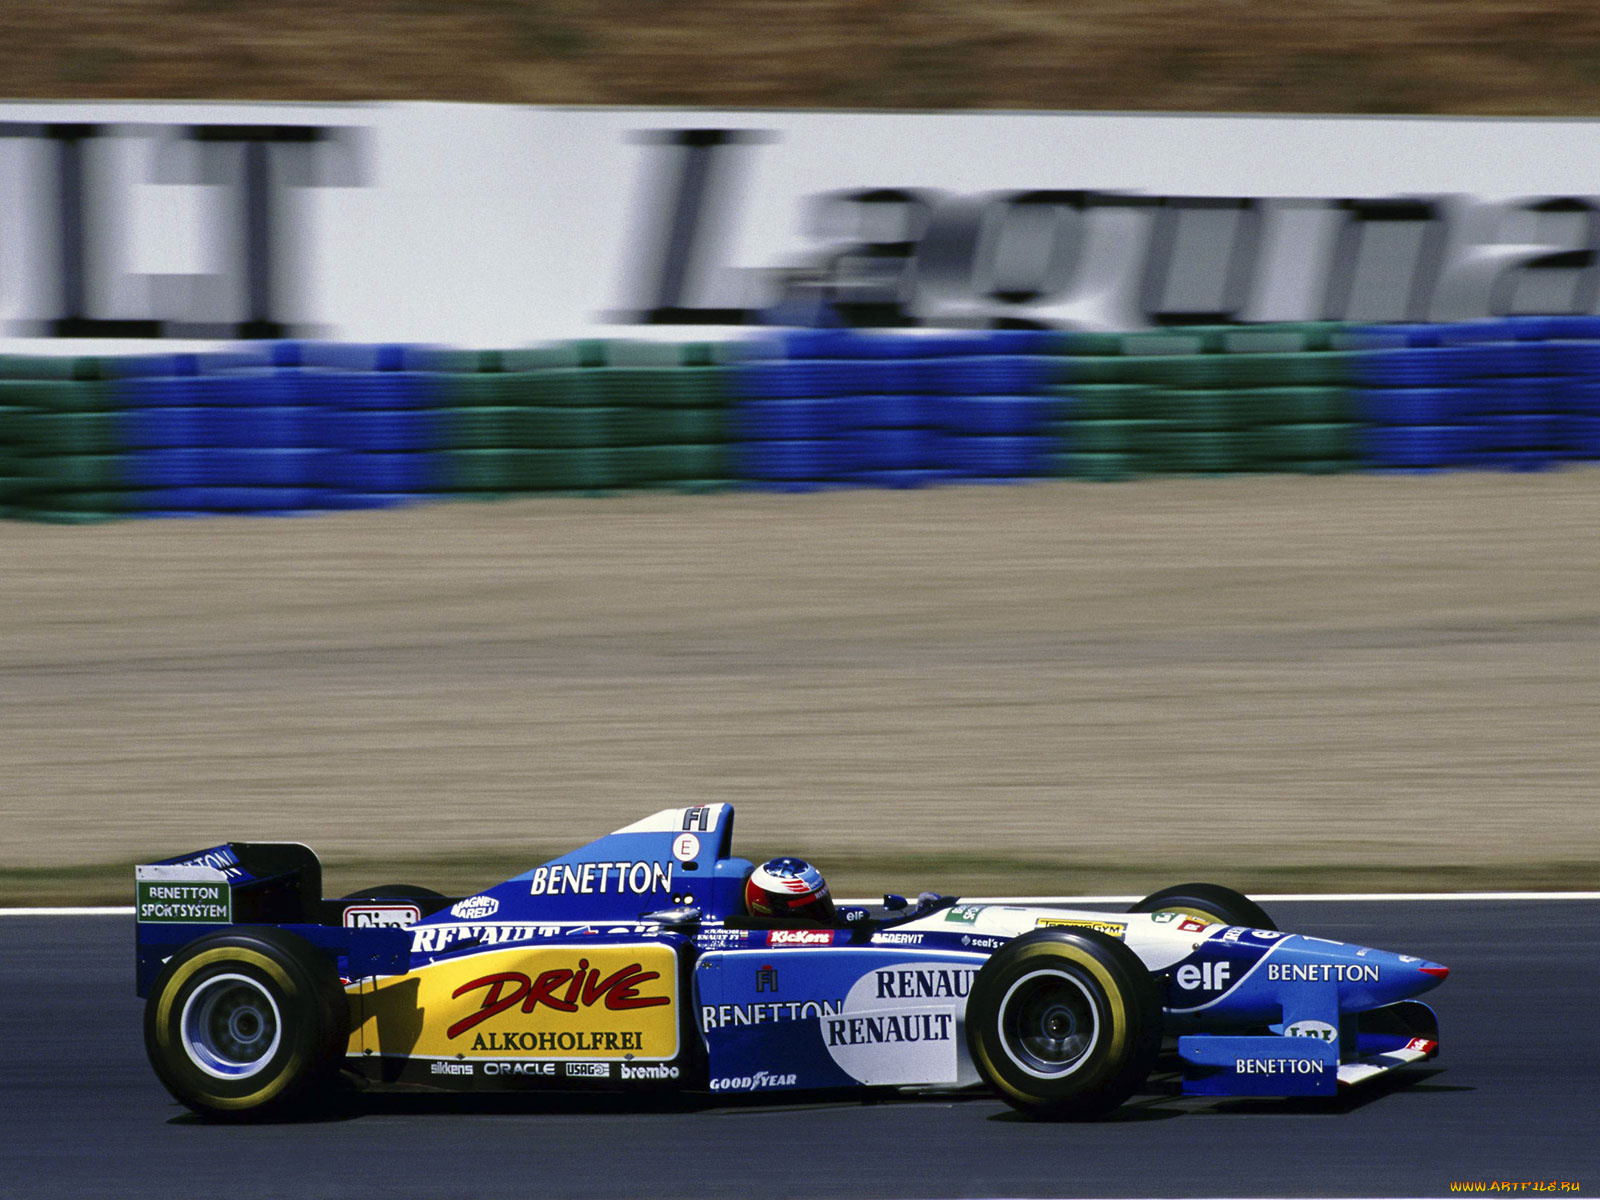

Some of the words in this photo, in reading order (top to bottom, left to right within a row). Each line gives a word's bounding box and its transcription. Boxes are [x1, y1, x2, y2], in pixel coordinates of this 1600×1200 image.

[681, 840, 692, 856] E
[530, 861, 673, 895] BENETTON
[149, 886, 219, 899] BENETTON
[1177, 961, 1231, 991] elf
[1267, 963, 1380, 982] BENETTON
[876, 969, 976, 999] RENAU
[827, 1013, 953, 1047] RENAULT
[471, 1031, 643, 1052] ALKOHOLFREI
[430, 1062, 474, 1075] sikkens
[483, 1062, 556, 1076] ORACLE
[567, 1063, 596, 1077] USAG
[620, 1063, 680, 1080] brembo
[1235, 1058, 1324, 1074] BENETTON
[709, 1071, 797, 1091] GOODYEAR
